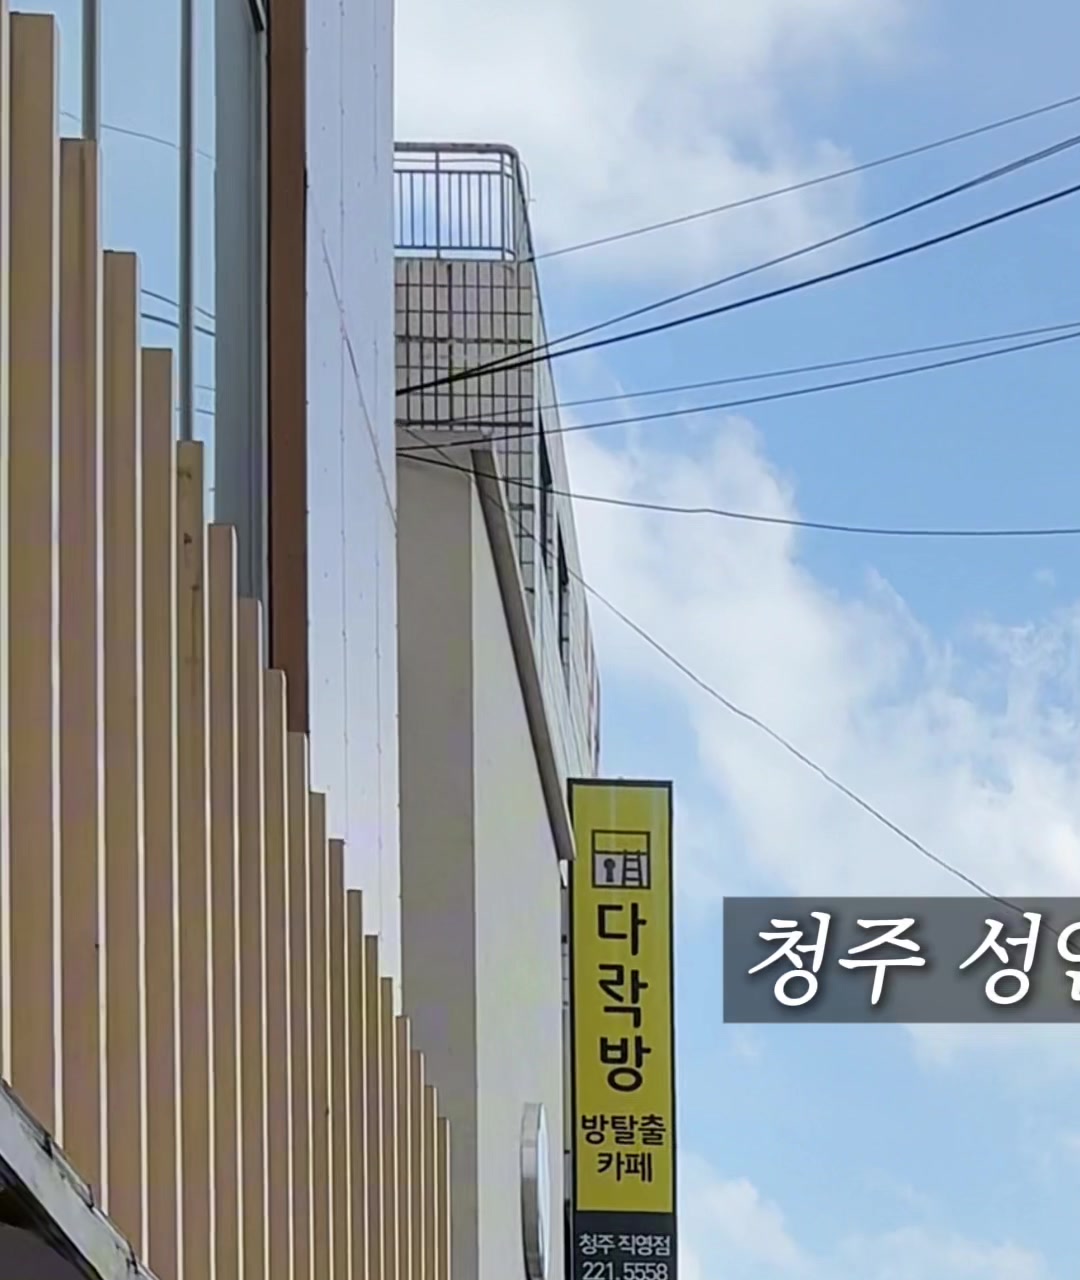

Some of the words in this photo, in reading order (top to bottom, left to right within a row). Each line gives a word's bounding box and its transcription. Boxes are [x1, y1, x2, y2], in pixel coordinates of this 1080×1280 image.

[597, 902, 652, 1093] 다락방
[580, 1113, 667, 1146] 방탈출
[597, 1151, 653, 1183] 카페
[578, 1233, 615, 1257] 청주
[617, 1233, 671, 1257] 직영점
